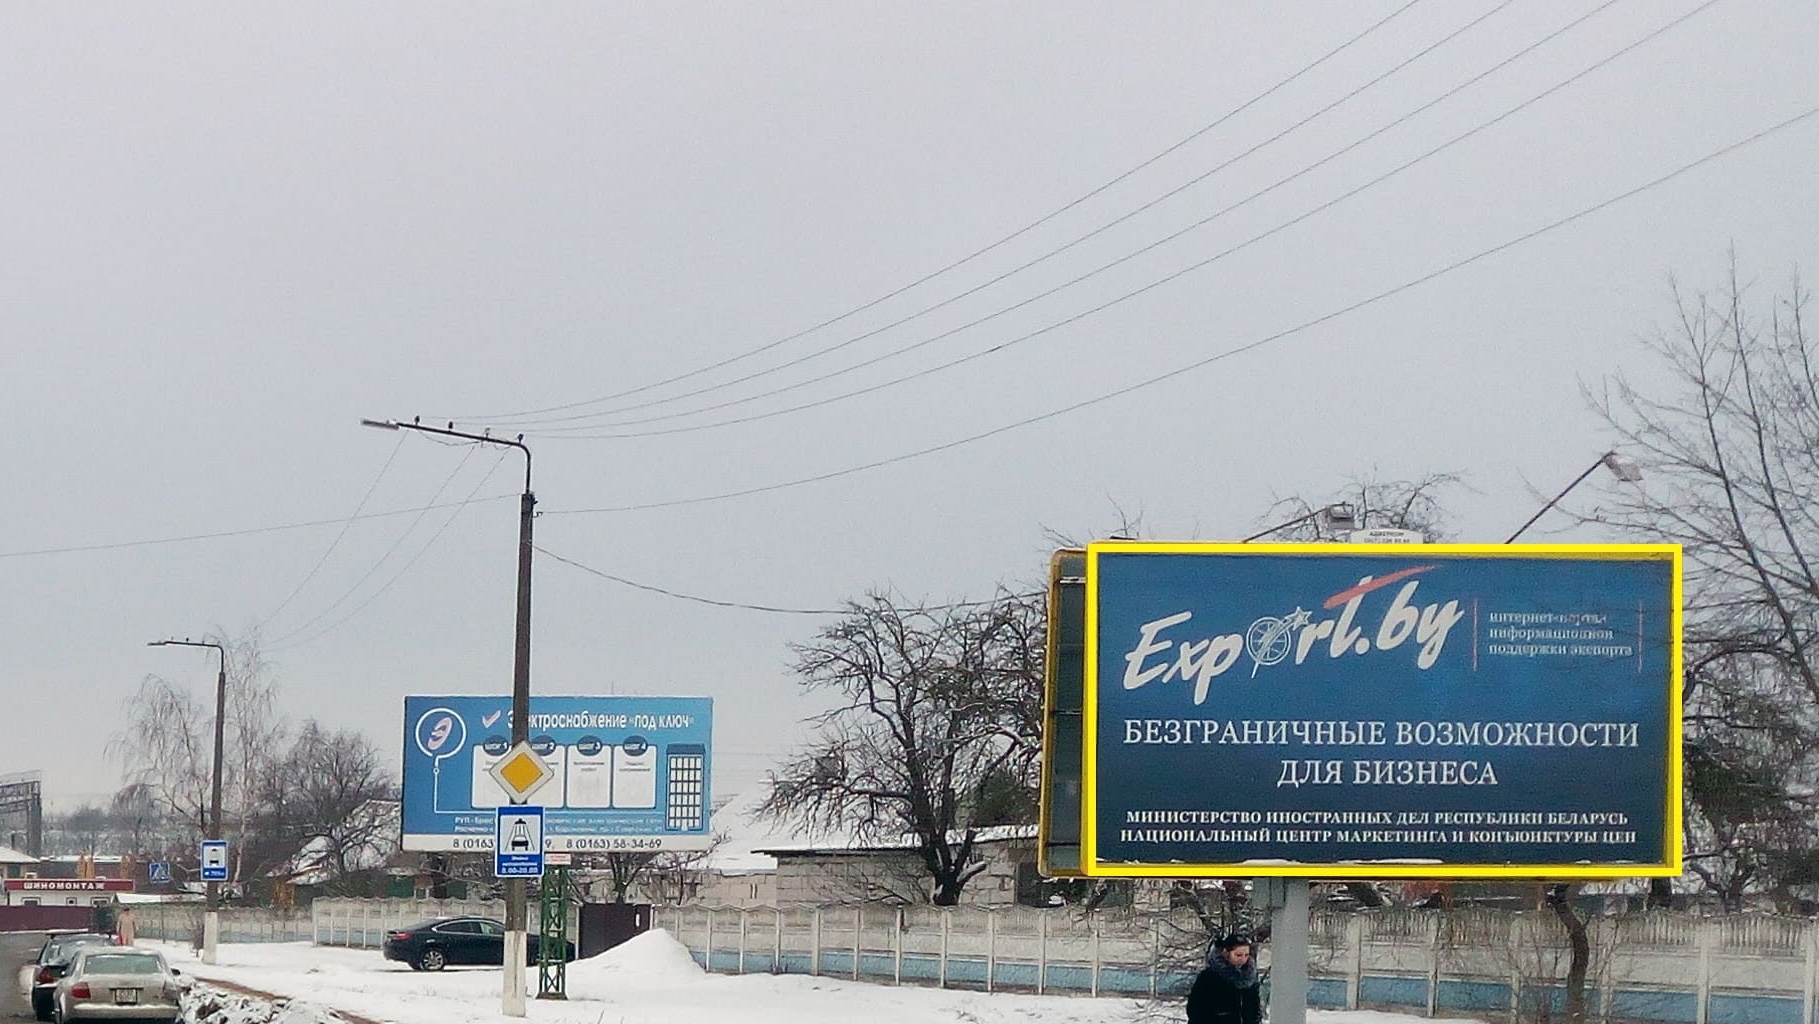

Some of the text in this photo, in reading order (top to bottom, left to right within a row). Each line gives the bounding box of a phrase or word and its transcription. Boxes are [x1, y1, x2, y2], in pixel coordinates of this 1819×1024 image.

[1488, 643, 1634, 658] поддержки экспорта
[507, 709, 627, 732] Эктроснабжение
[1122, 718, 1640, 748] БЕЗГРАНИЧНЫЕ ВОЗМОЖНОСТИ
[1276, 759, 1499, 788] ДЛЯ БИЗНЕСА
[1125, 810, 1629, 826] МИНИСТЕРСТВО ИНОСТРАННЫХ ДЕЛ РЕСПУБЛИКИ БЕЛАРУСЬ
[452, 838, 495, 849] 8 (0163
[565, 838, 573, 849] 8
[575, 838, 611, 850] (0163)
[612, 838, 663, 850] 58-34-69
[1119, 828, 1638, 845] НАЦИОНАЛЬНЫЙ ЦЕНТР МАРКЕТИНГА И КОНЪЮНКТУРЫ ЦЕН
[23, 882, 105, 890] ШИНОМОНТАЖ
